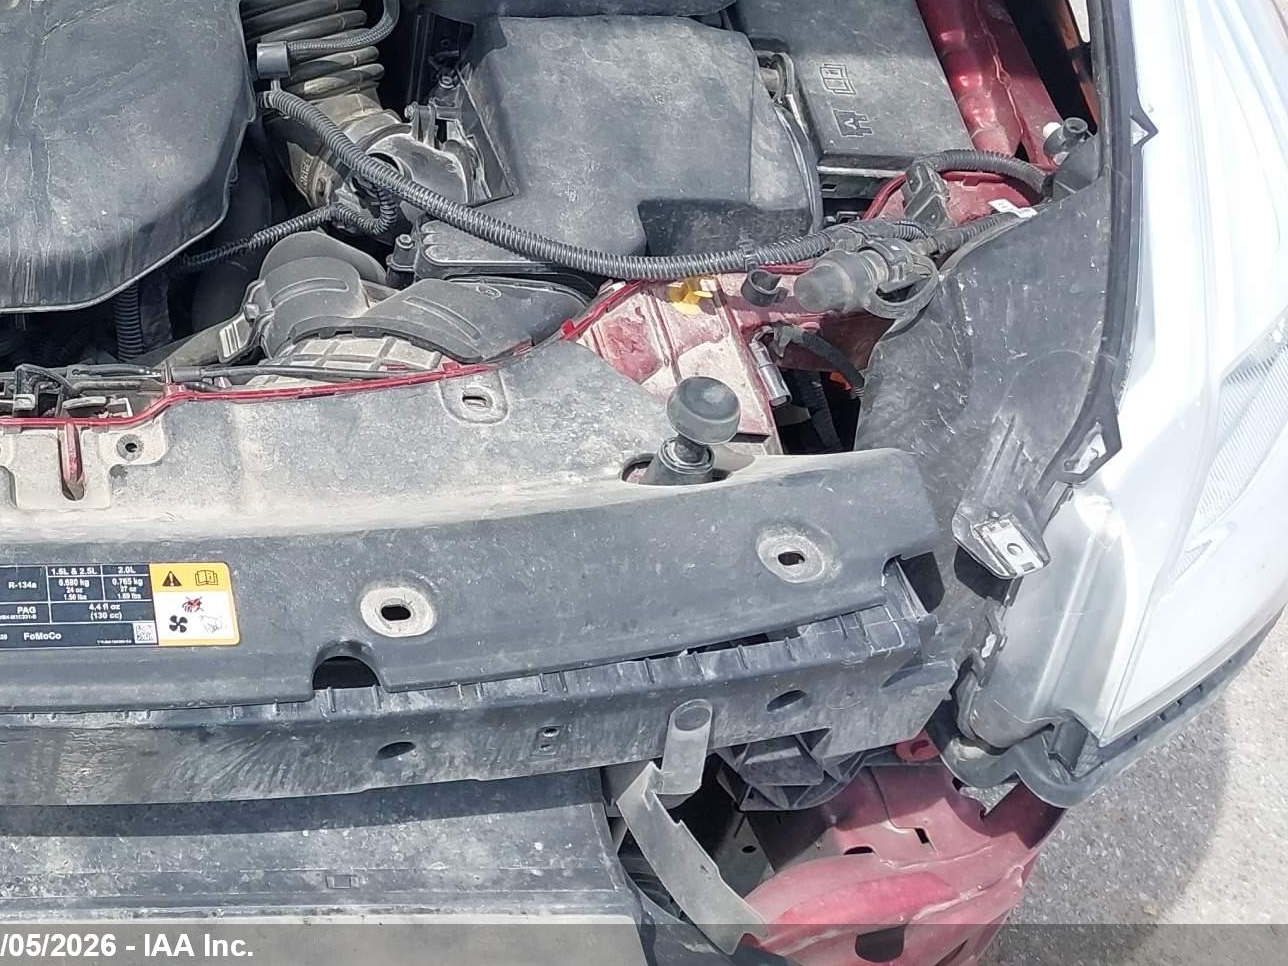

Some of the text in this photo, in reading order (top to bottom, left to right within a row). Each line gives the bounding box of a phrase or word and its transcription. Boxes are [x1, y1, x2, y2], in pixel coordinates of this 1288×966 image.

[79, 567, 98, 575] 2.5L
[117, 566, 136, 574] 2.0L
[8, 581, 38, 589] R-134a
[79, 579, 90, 587] kg
[112, 578, 144, 587] 0.765 kg
[17, 606, 37, 614] PAG
[90, 612, 123, 621] (130 cc)
[23, 632, 62, 641] FoMoCo
